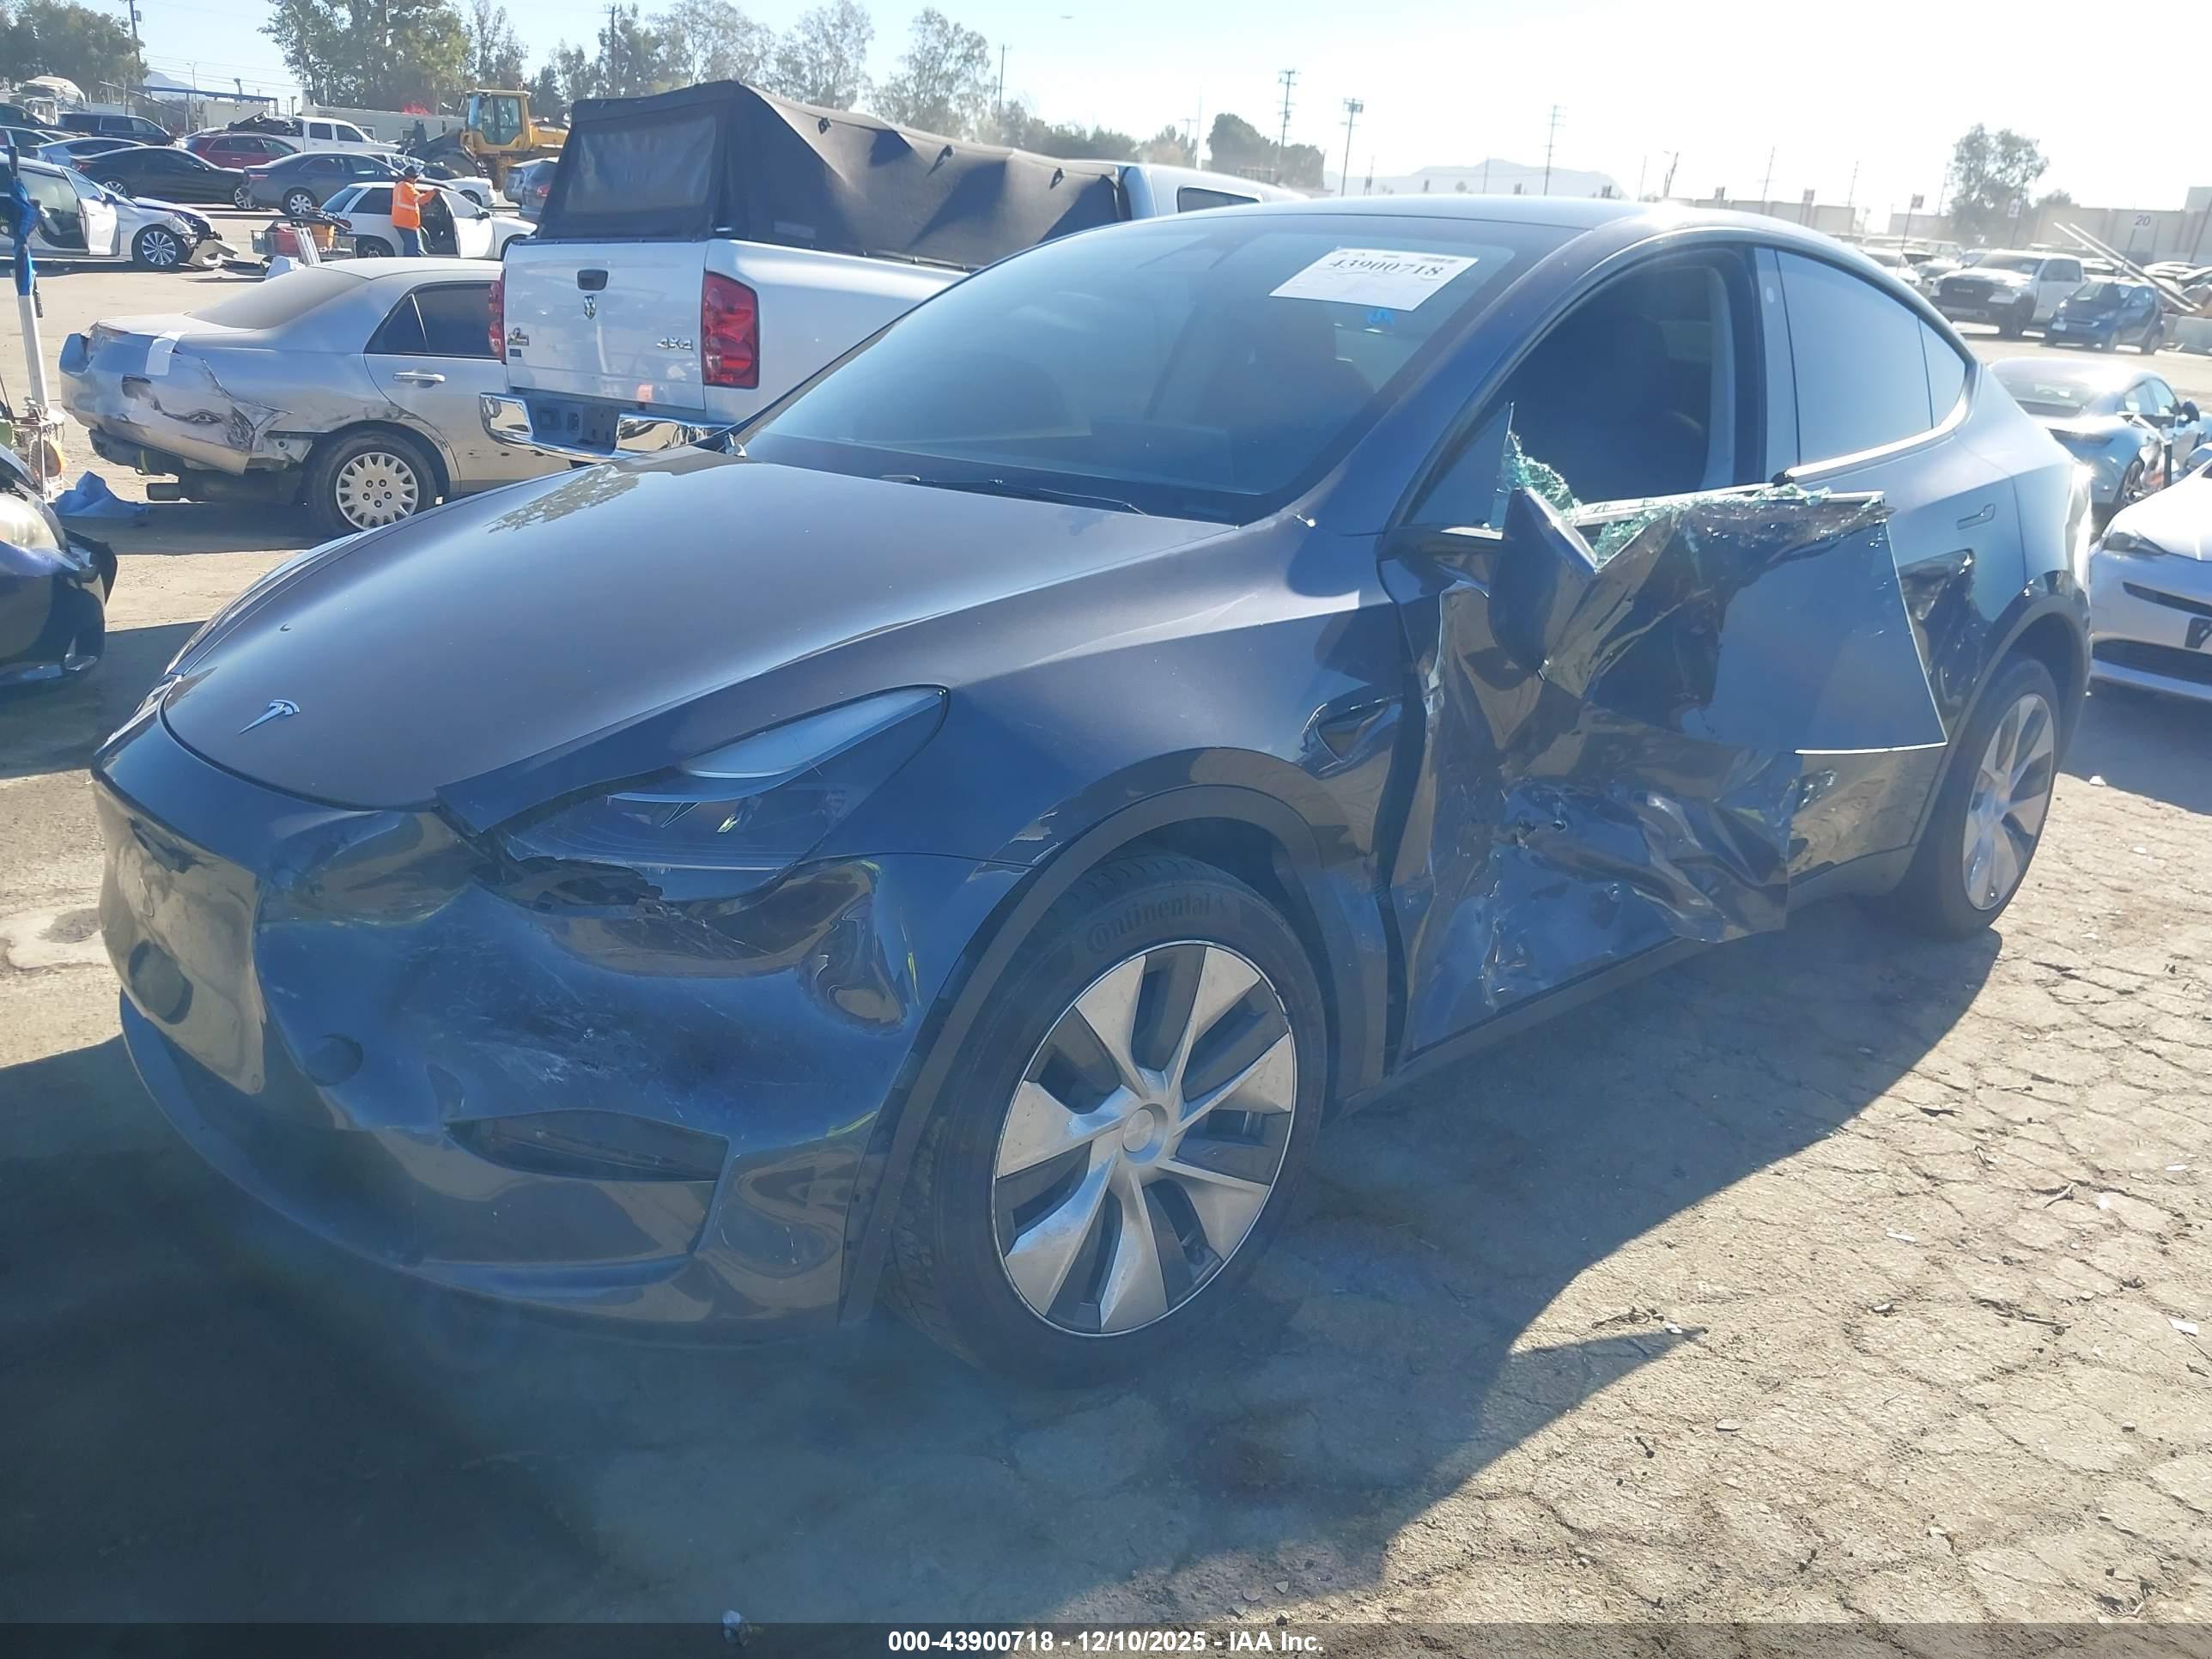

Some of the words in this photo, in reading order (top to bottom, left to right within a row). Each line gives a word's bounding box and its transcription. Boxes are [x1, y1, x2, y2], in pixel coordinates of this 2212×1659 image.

[2134, 214, 2151, 228] 20
[1328, 258, 1444, 276] 43900718
[1086, 891, 1210, 955] Continental
